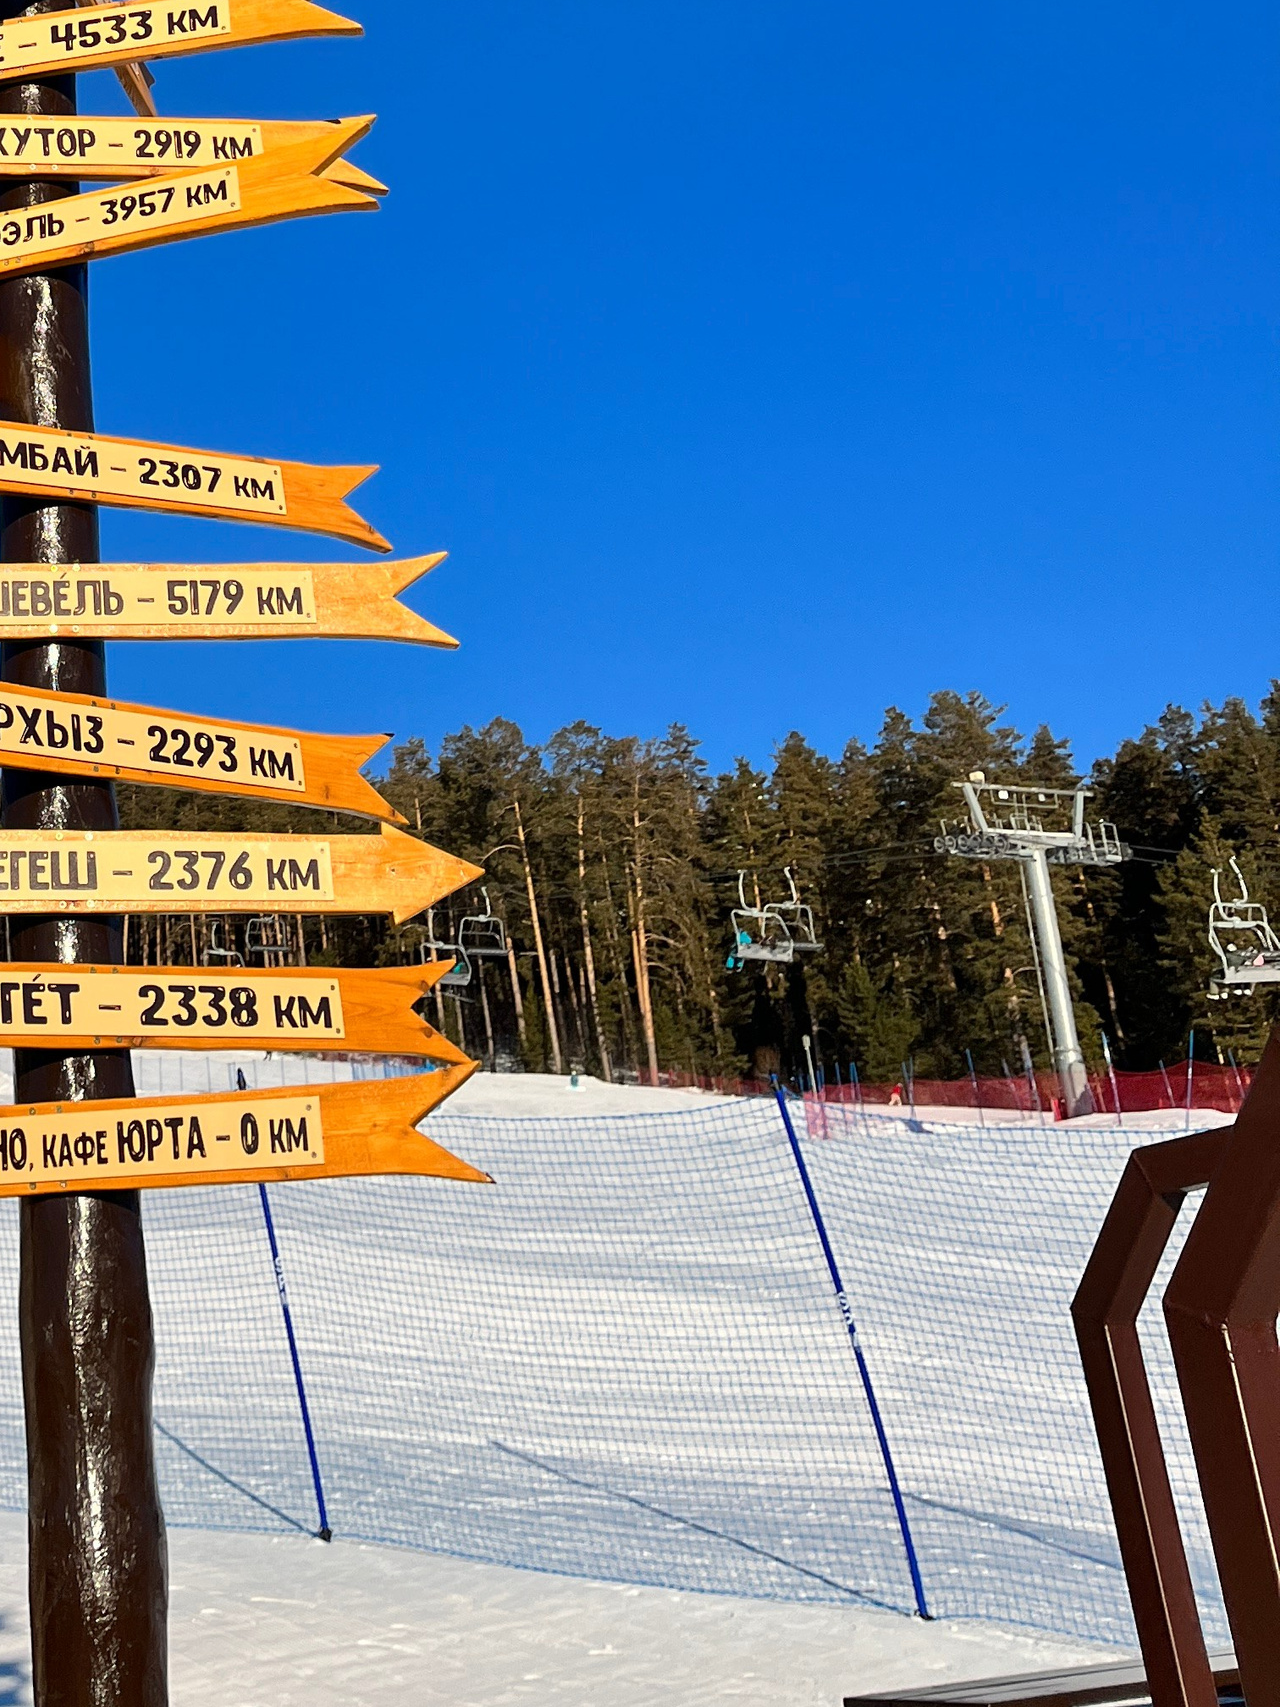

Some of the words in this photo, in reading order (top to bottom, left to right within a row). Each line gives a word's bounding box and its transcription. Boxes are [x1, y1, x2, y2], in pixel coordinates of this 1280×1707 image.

[50, 10, 153, 51] 4533
[135, 129, 201, 159] 2919
[101, 188, 175, 226] 3957
[138, 458, 221, 493] 2307
[167, 579, 243, 615] 5179
[148, 725, 238, 772] 2293
[148, 851, 252, 890] 2376
[138, 984, 259, 1027] 2338
[43, 1131, 108, 1167] КАФЕ
[117, 1116, 207, 1163] ЮРТА
[241, 1112, 258, 1155] 0
